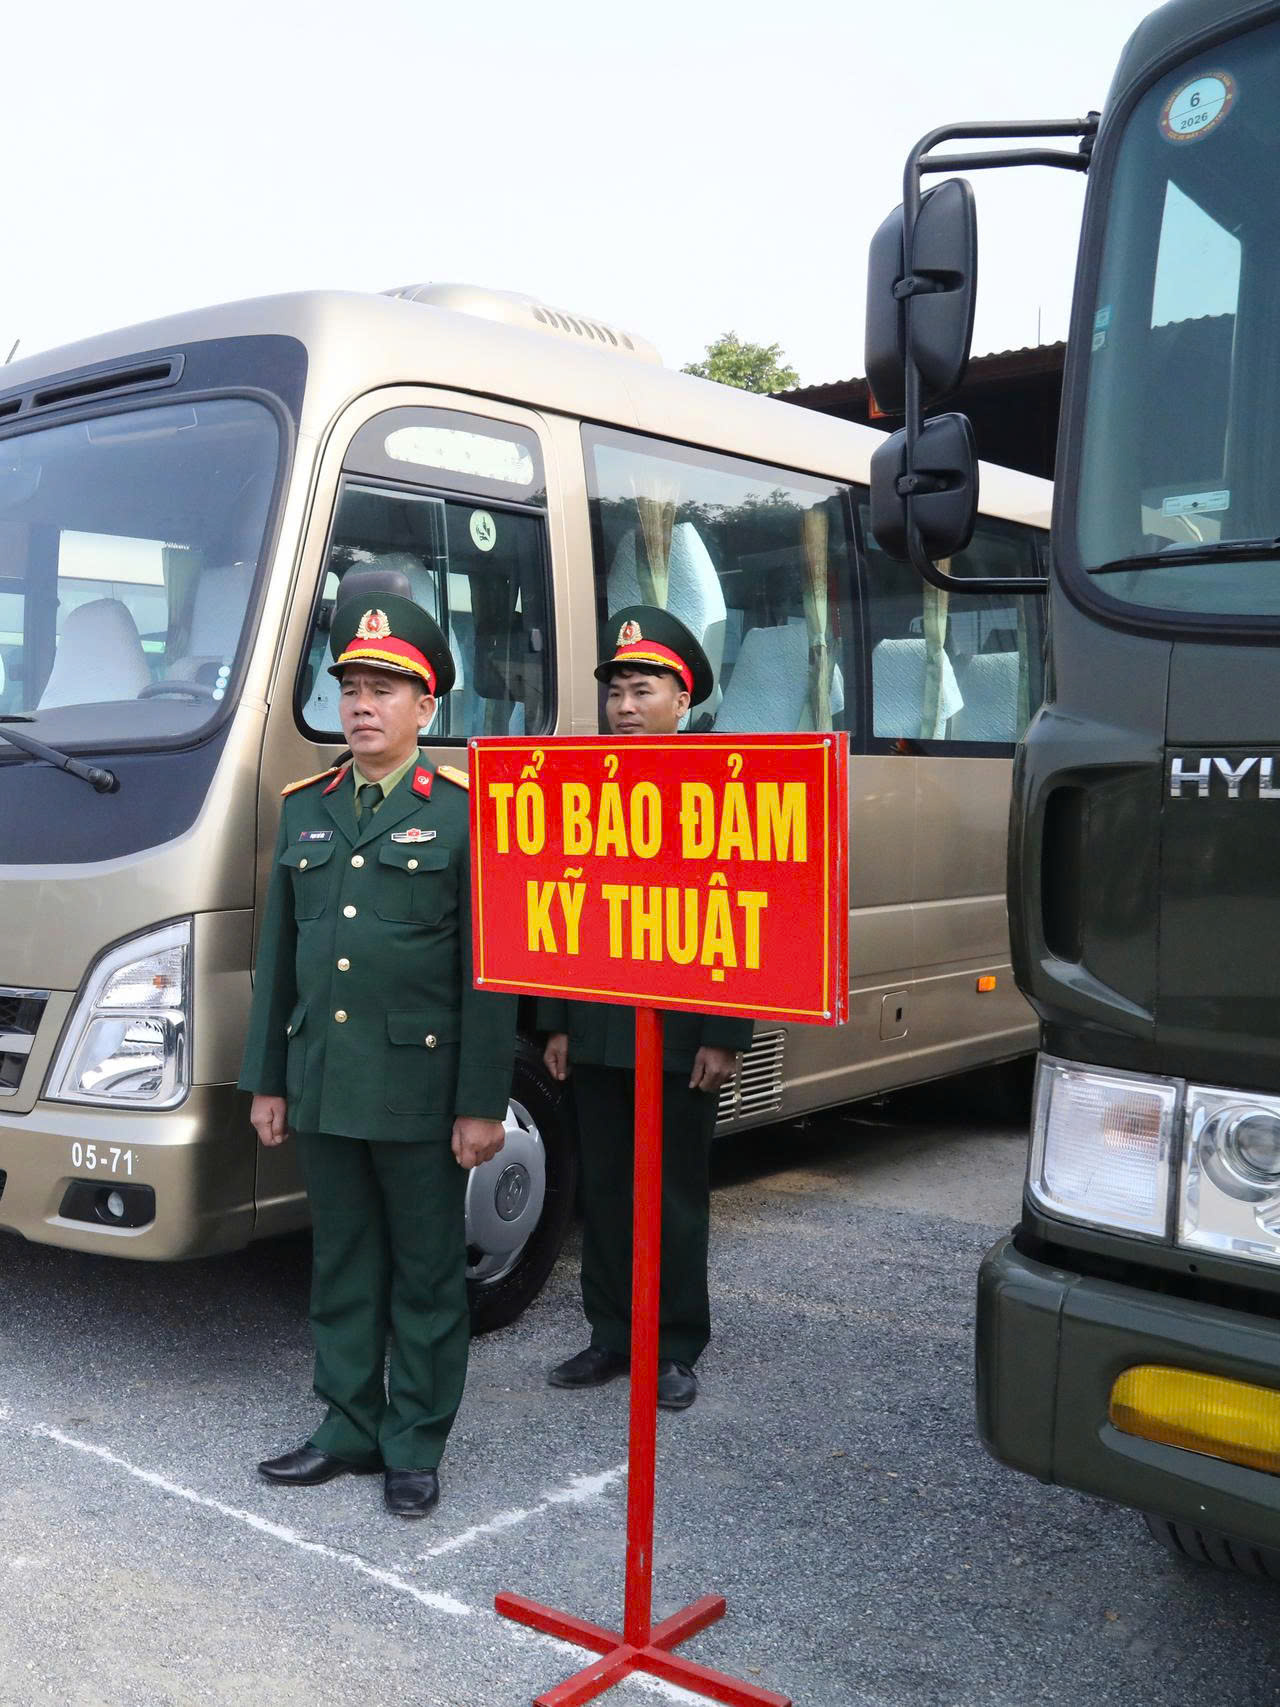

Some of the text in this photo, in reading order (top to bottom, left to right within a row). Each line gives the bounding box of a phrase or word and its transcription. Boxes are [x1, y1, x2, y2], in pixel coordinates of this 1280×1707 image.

[1190, 92, 1200, 107] 6
[1180, 112, 1208, 129] 2026
[489, 750, 807, 862] TỔ BẢO ĐẢM
[527, 867, 768, 982] KỸ THUẬT
[72, 1142, 132, 1176] 05-71
